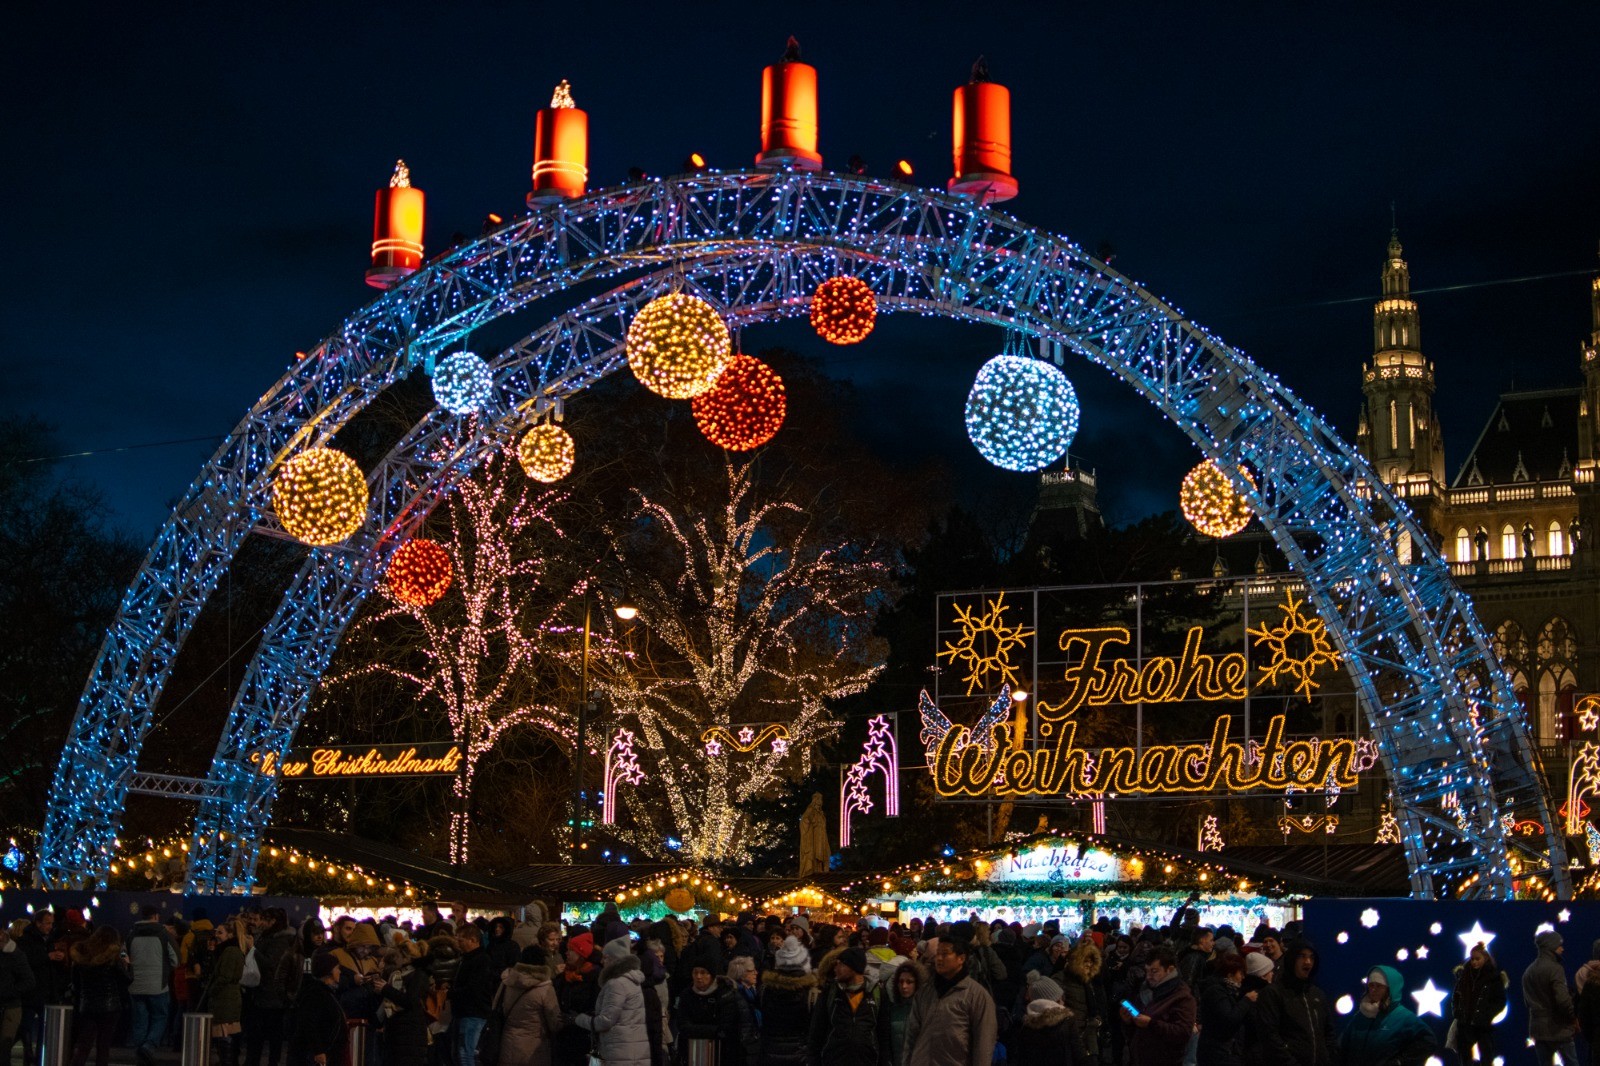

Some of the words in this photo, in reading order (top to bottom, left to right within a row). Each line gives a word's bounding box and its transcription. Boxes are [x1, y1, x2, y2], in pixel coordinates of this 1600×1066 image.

[1037, 626, 1248, 721] Frohe
[251, 751, 308, 776] Wner
[312, 747, 463, 775] Christkindlmarkt
[935, 714, 1359, 796] Weihnachten
